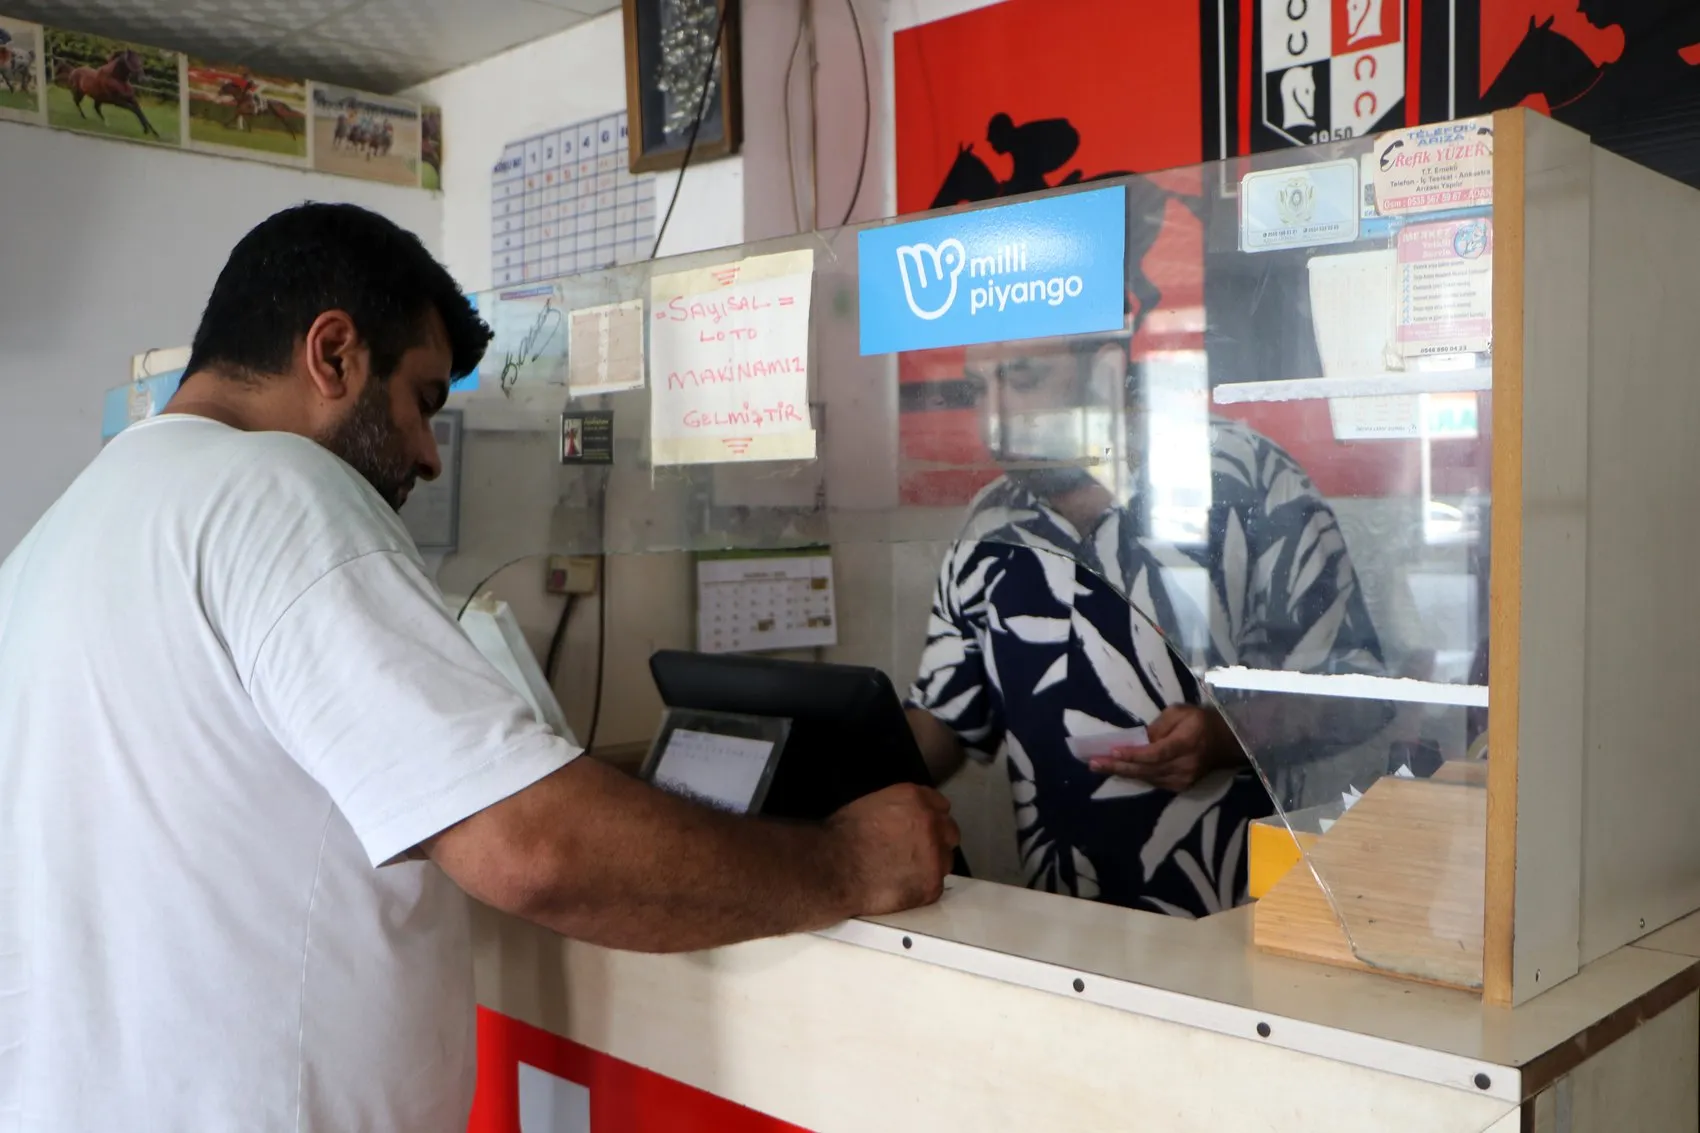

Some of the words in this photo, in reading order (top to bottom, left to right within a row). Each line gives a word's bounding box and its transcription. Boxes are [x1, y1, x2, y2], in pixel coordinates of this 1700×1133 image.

[1309, 126, 1353, 144] 1950
[1395, 150, 1431, 168] Refik
[1437, 141, 1485, 162] YÜZER
[970, 243, 1027, 278] milli
[970, 275, 1083, 315] piyango
[700, 328, 758, 342] LOTO
